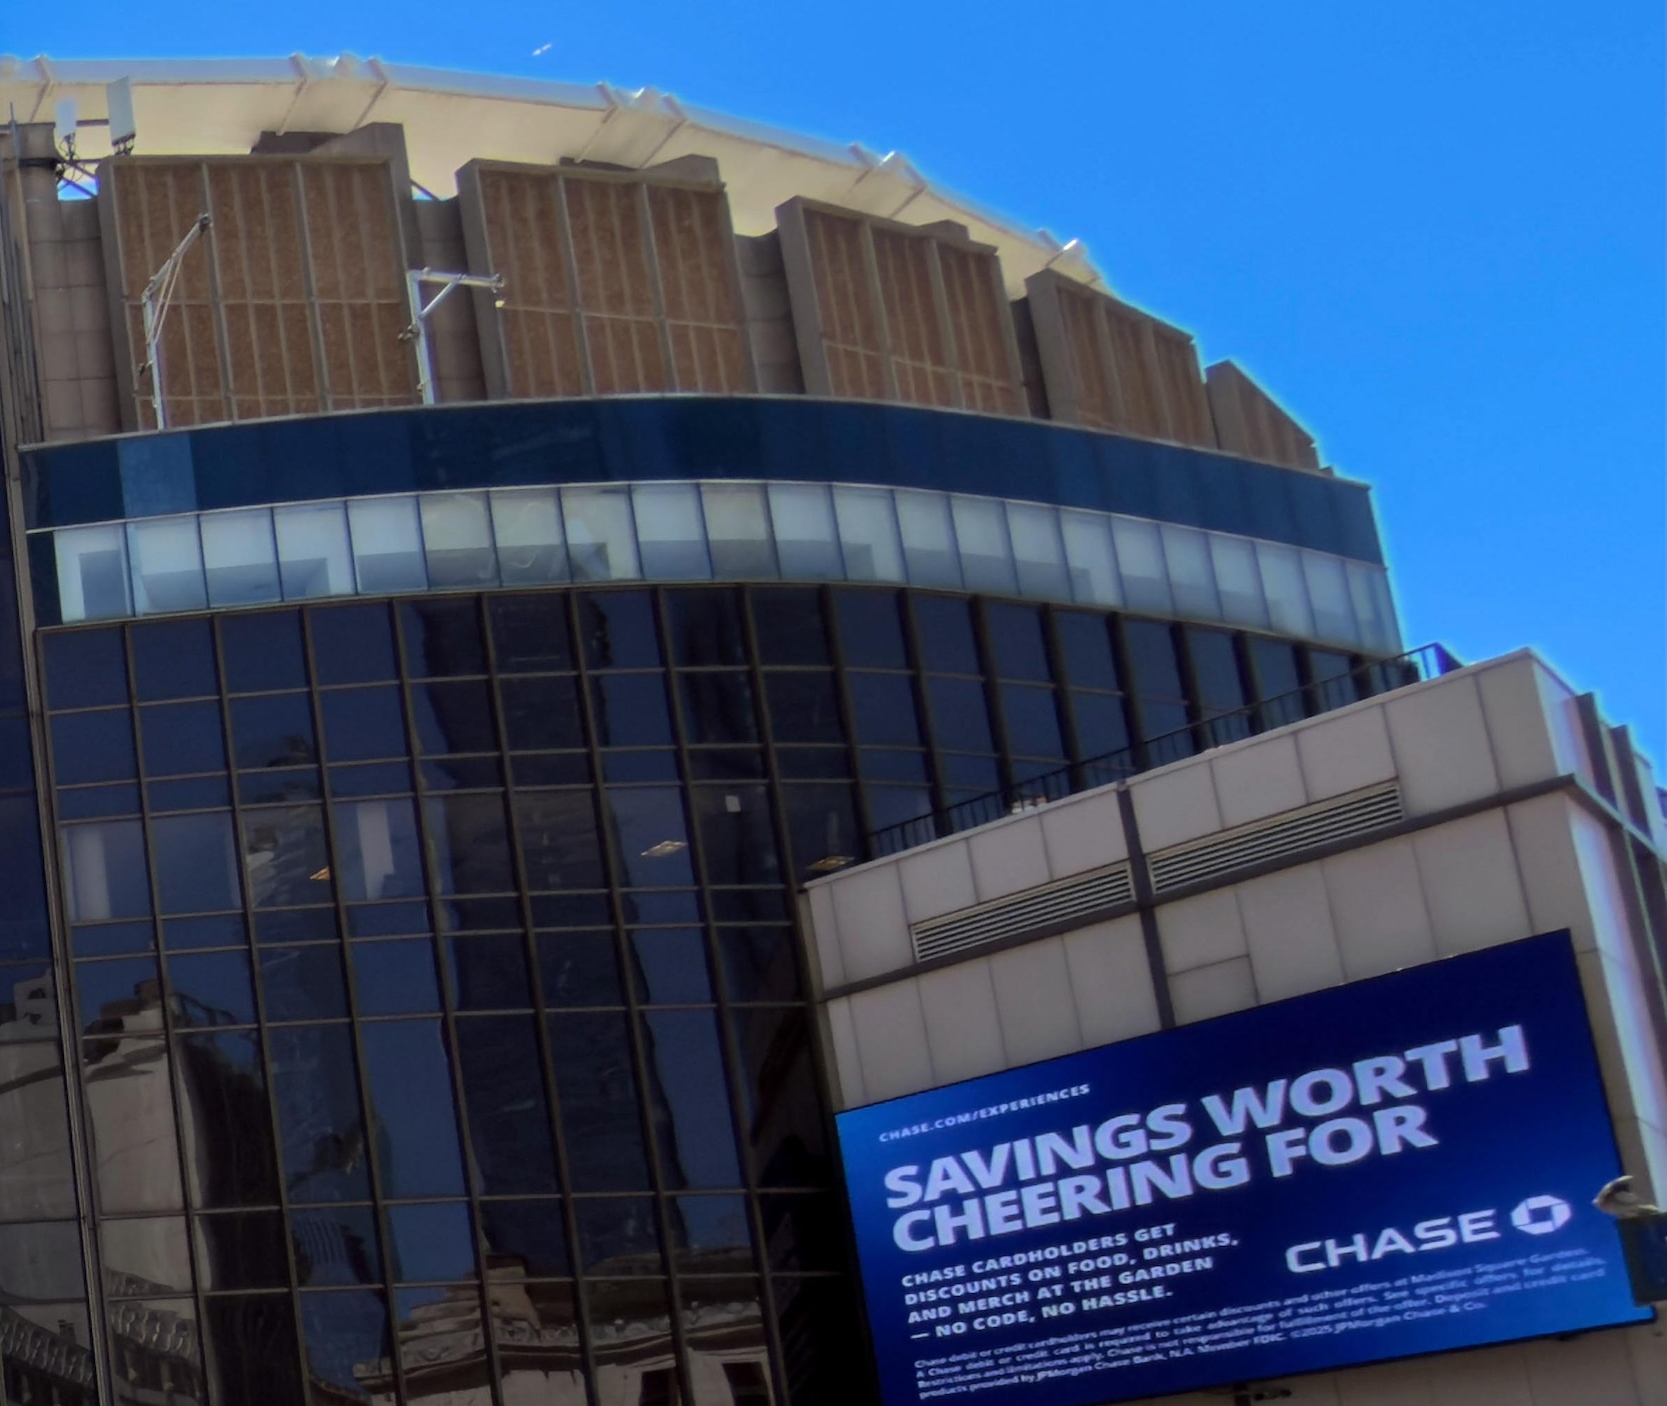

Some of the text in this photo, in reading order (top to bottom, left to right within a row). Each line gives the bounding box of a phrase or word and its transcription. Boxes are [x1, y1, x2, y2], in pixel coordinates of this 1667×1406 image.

[879, 1084, 1089, 1141] CHASE.COM/EXPERIENCES
[884, 1025, 1529, 1209] SAVINGS WORTH
[893, 1104, 1438, 1252] CHEERING FOR
[901, 1223, 1174, 1286] CHASE CARDHOLDERS GET
[904, 1233, 1238, 1304] DISCOUNTS ON FOOD, DRINKS,
[1286, 1209, 1500, 1274] CHASE
[907, 1256, 1212, 1323] AND MERCH AT THE GARDEN
[935, 1321, 966, 1336] NO
[972, 1310, 1035, 1329] CODE,
[1041, 1302, 1075, 1317] NO
[1081, 1285, 1172, 1310] HASSLE.
